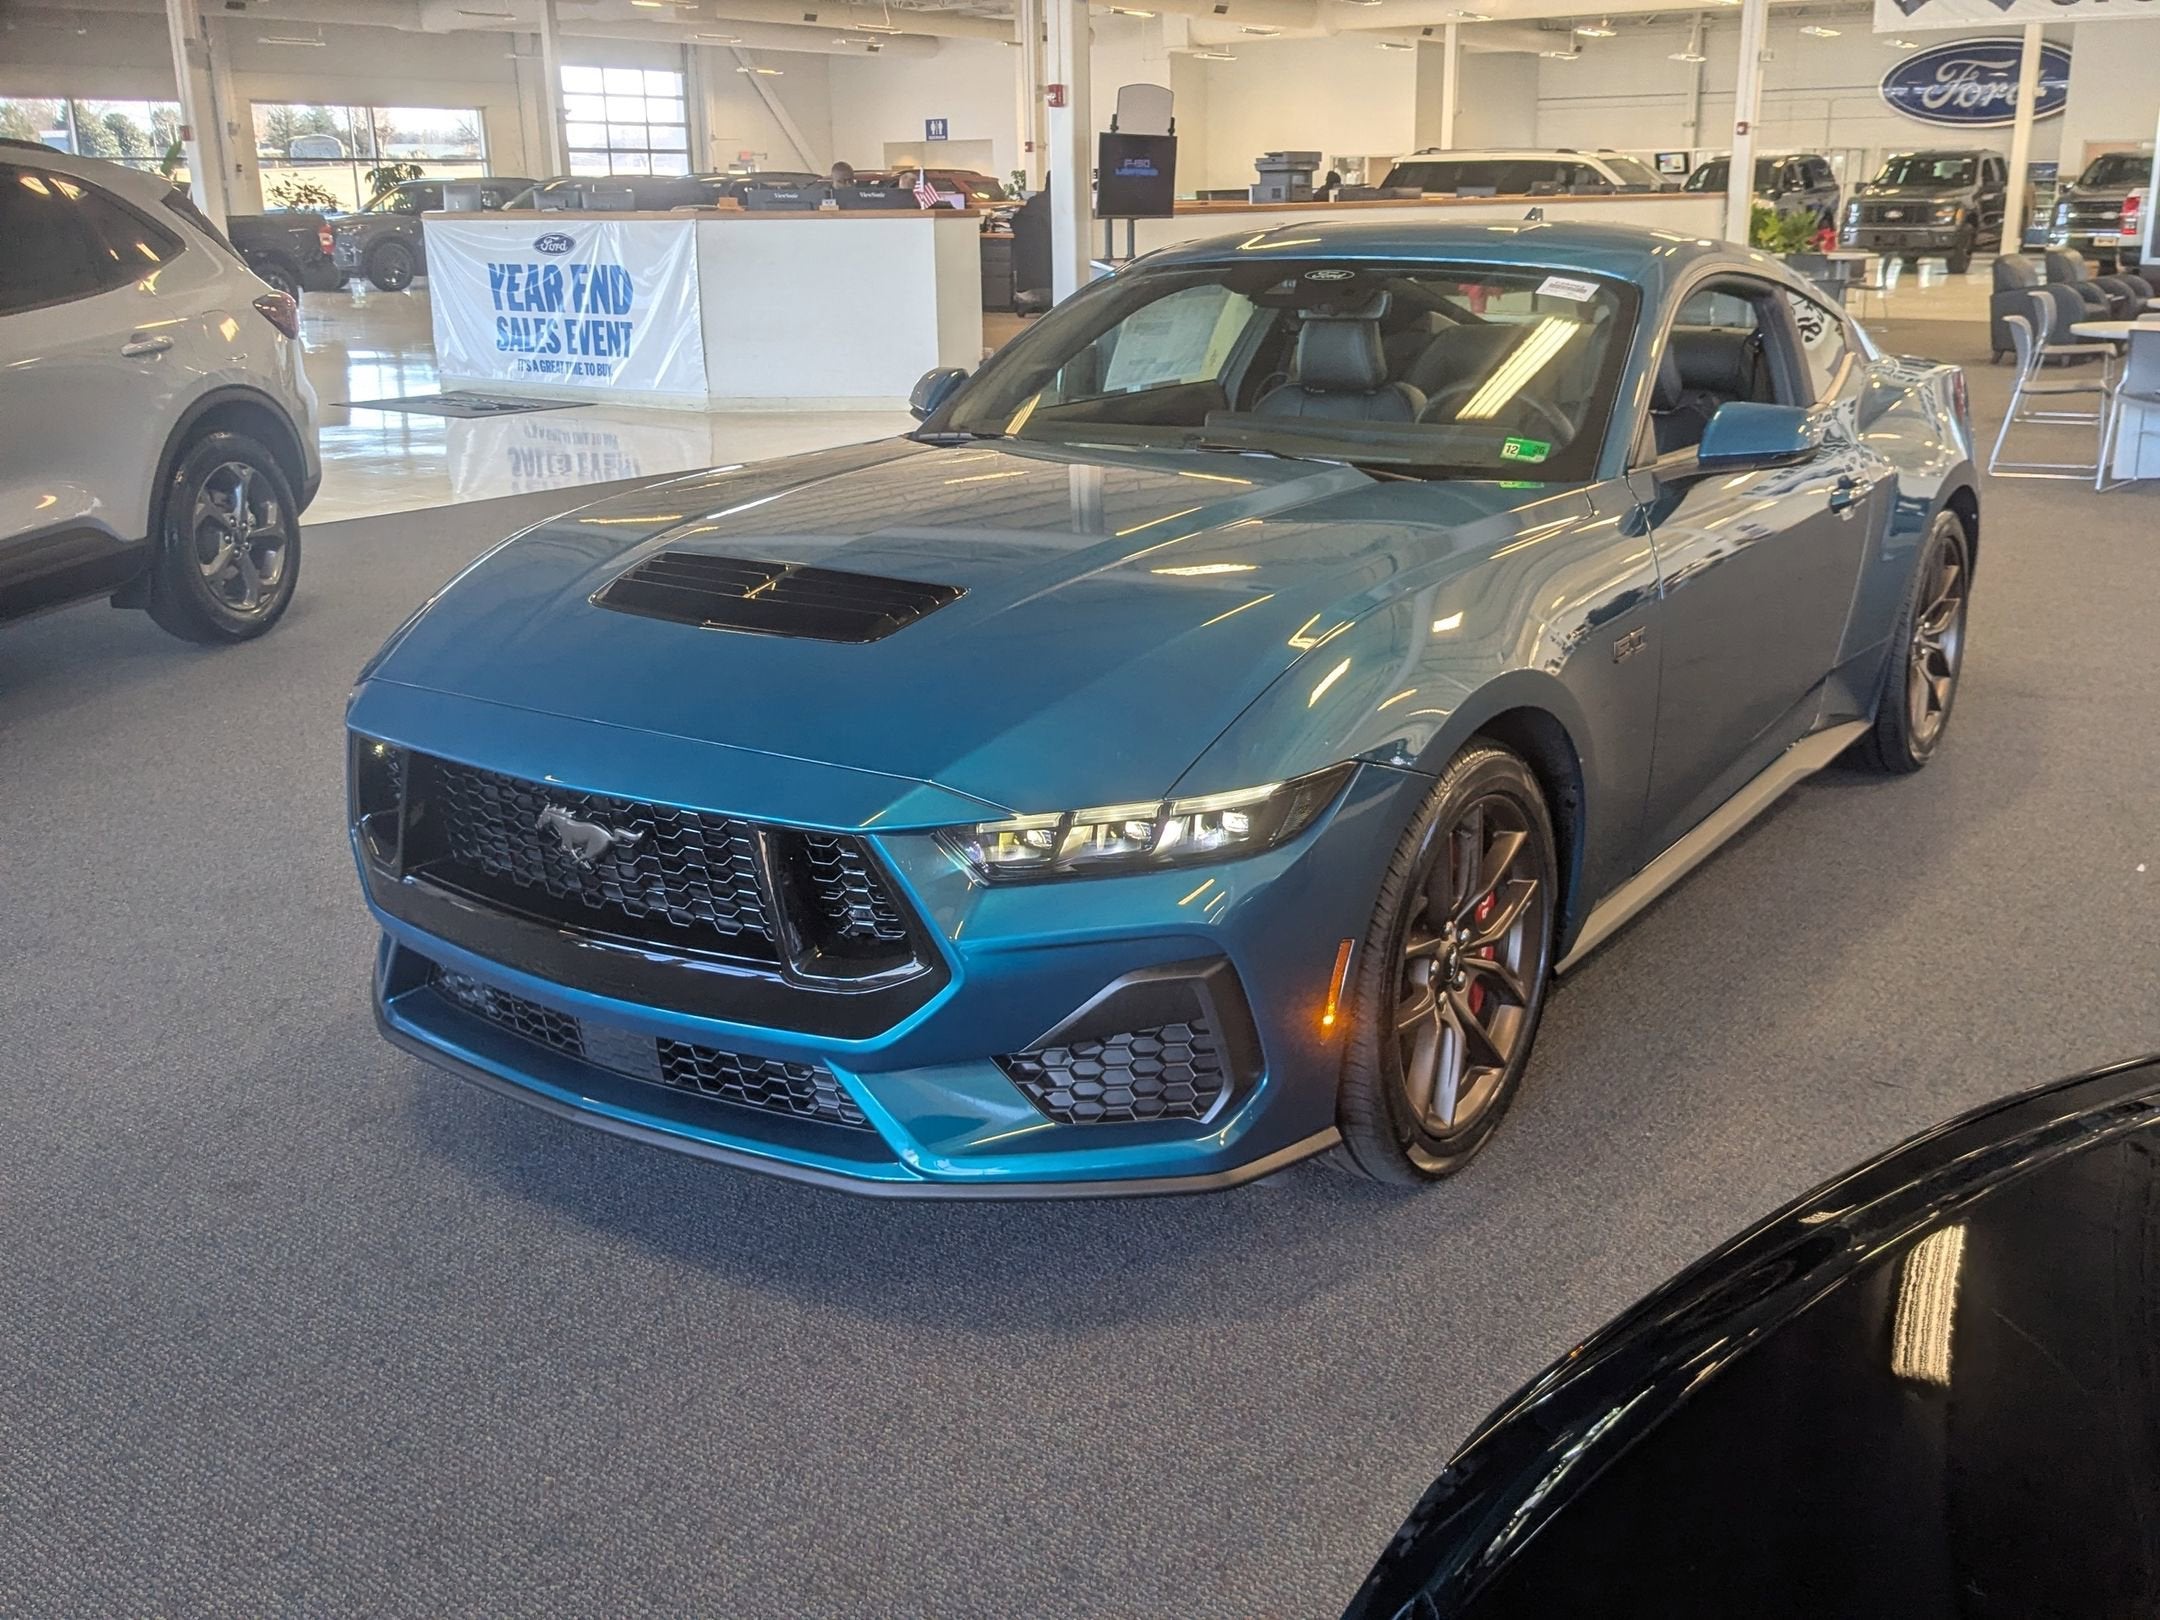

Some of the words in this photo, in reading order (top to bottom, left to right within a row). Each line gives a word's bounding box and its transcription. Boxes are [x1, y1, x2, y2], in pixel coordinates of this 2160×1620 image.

[540, 236, 568, 252] Ford
[487, 263, 565, 313] YEAR
[569, 264, 634, 315] END
[496, 316, 562, 354] SALES
[564, 319, 633, 358] EVENT
[517, 359, 532, 372] IT'S
[533, 360, 539, 372] A
[540, 360, 564, 374] GREAT
[584, 362, 596, 376] TO
[1505, 444, 1519, 455] 12
